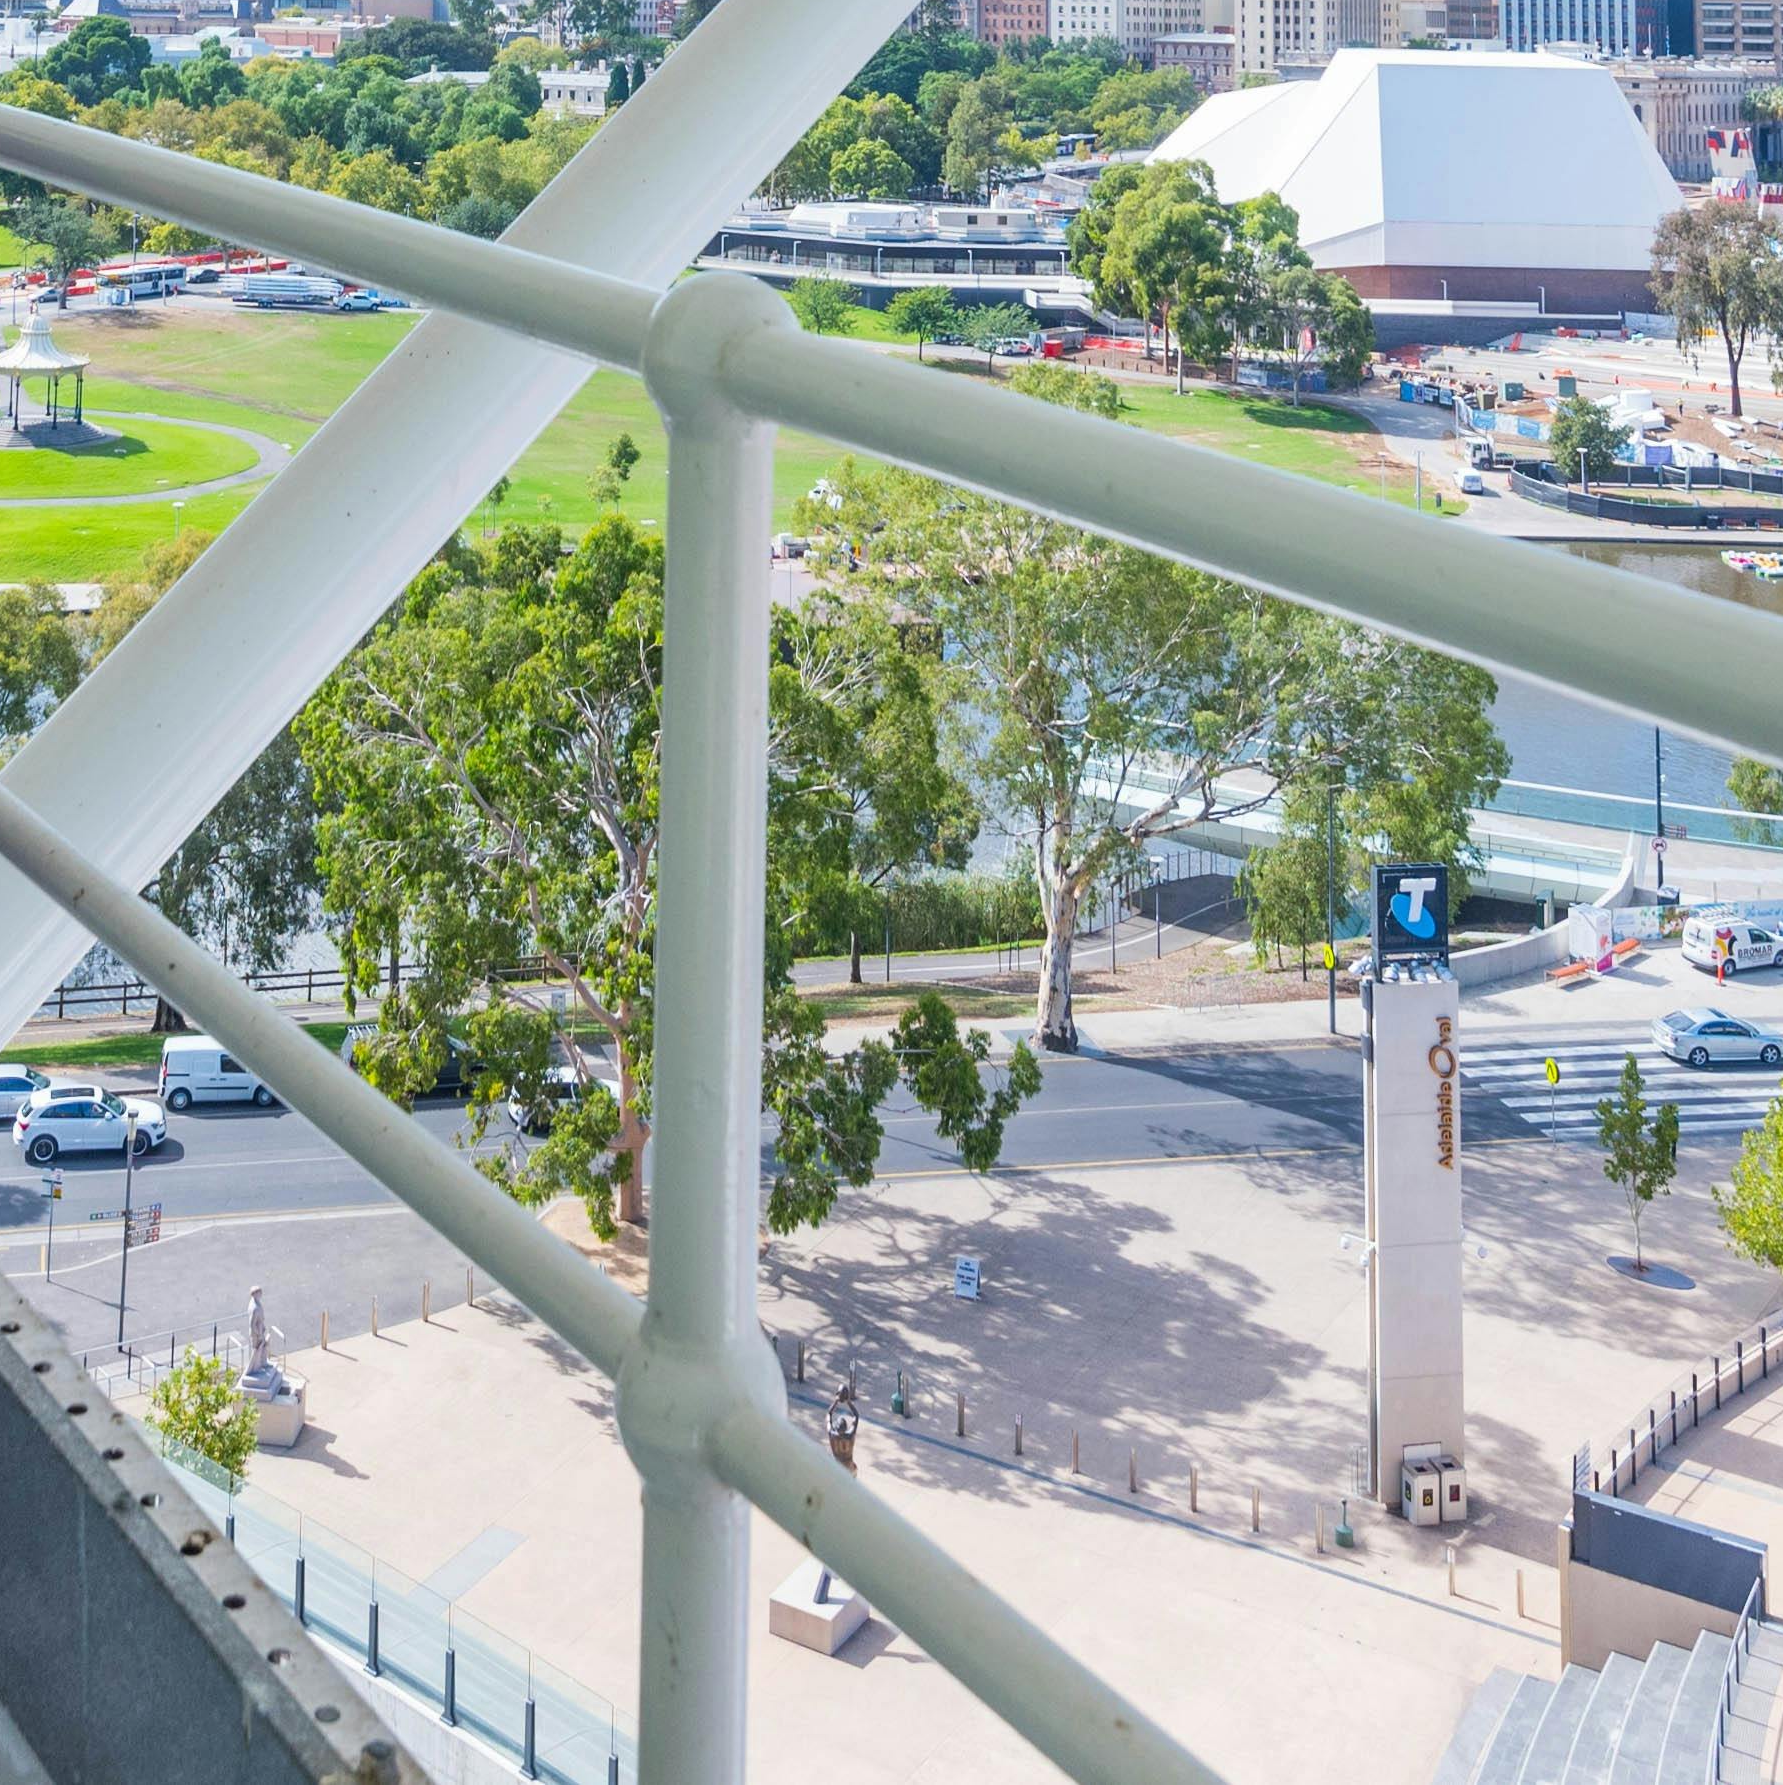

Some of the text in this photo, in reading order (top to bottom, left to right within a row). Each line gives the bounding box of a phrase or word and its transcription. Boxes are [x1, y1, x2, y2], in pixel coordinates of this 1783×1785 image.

[1399, 877, 1437, 923] T
[1737, 945, 1773, 959] BROMAR
[1428, 1016, 1456, 1170] Adelaide Oval
